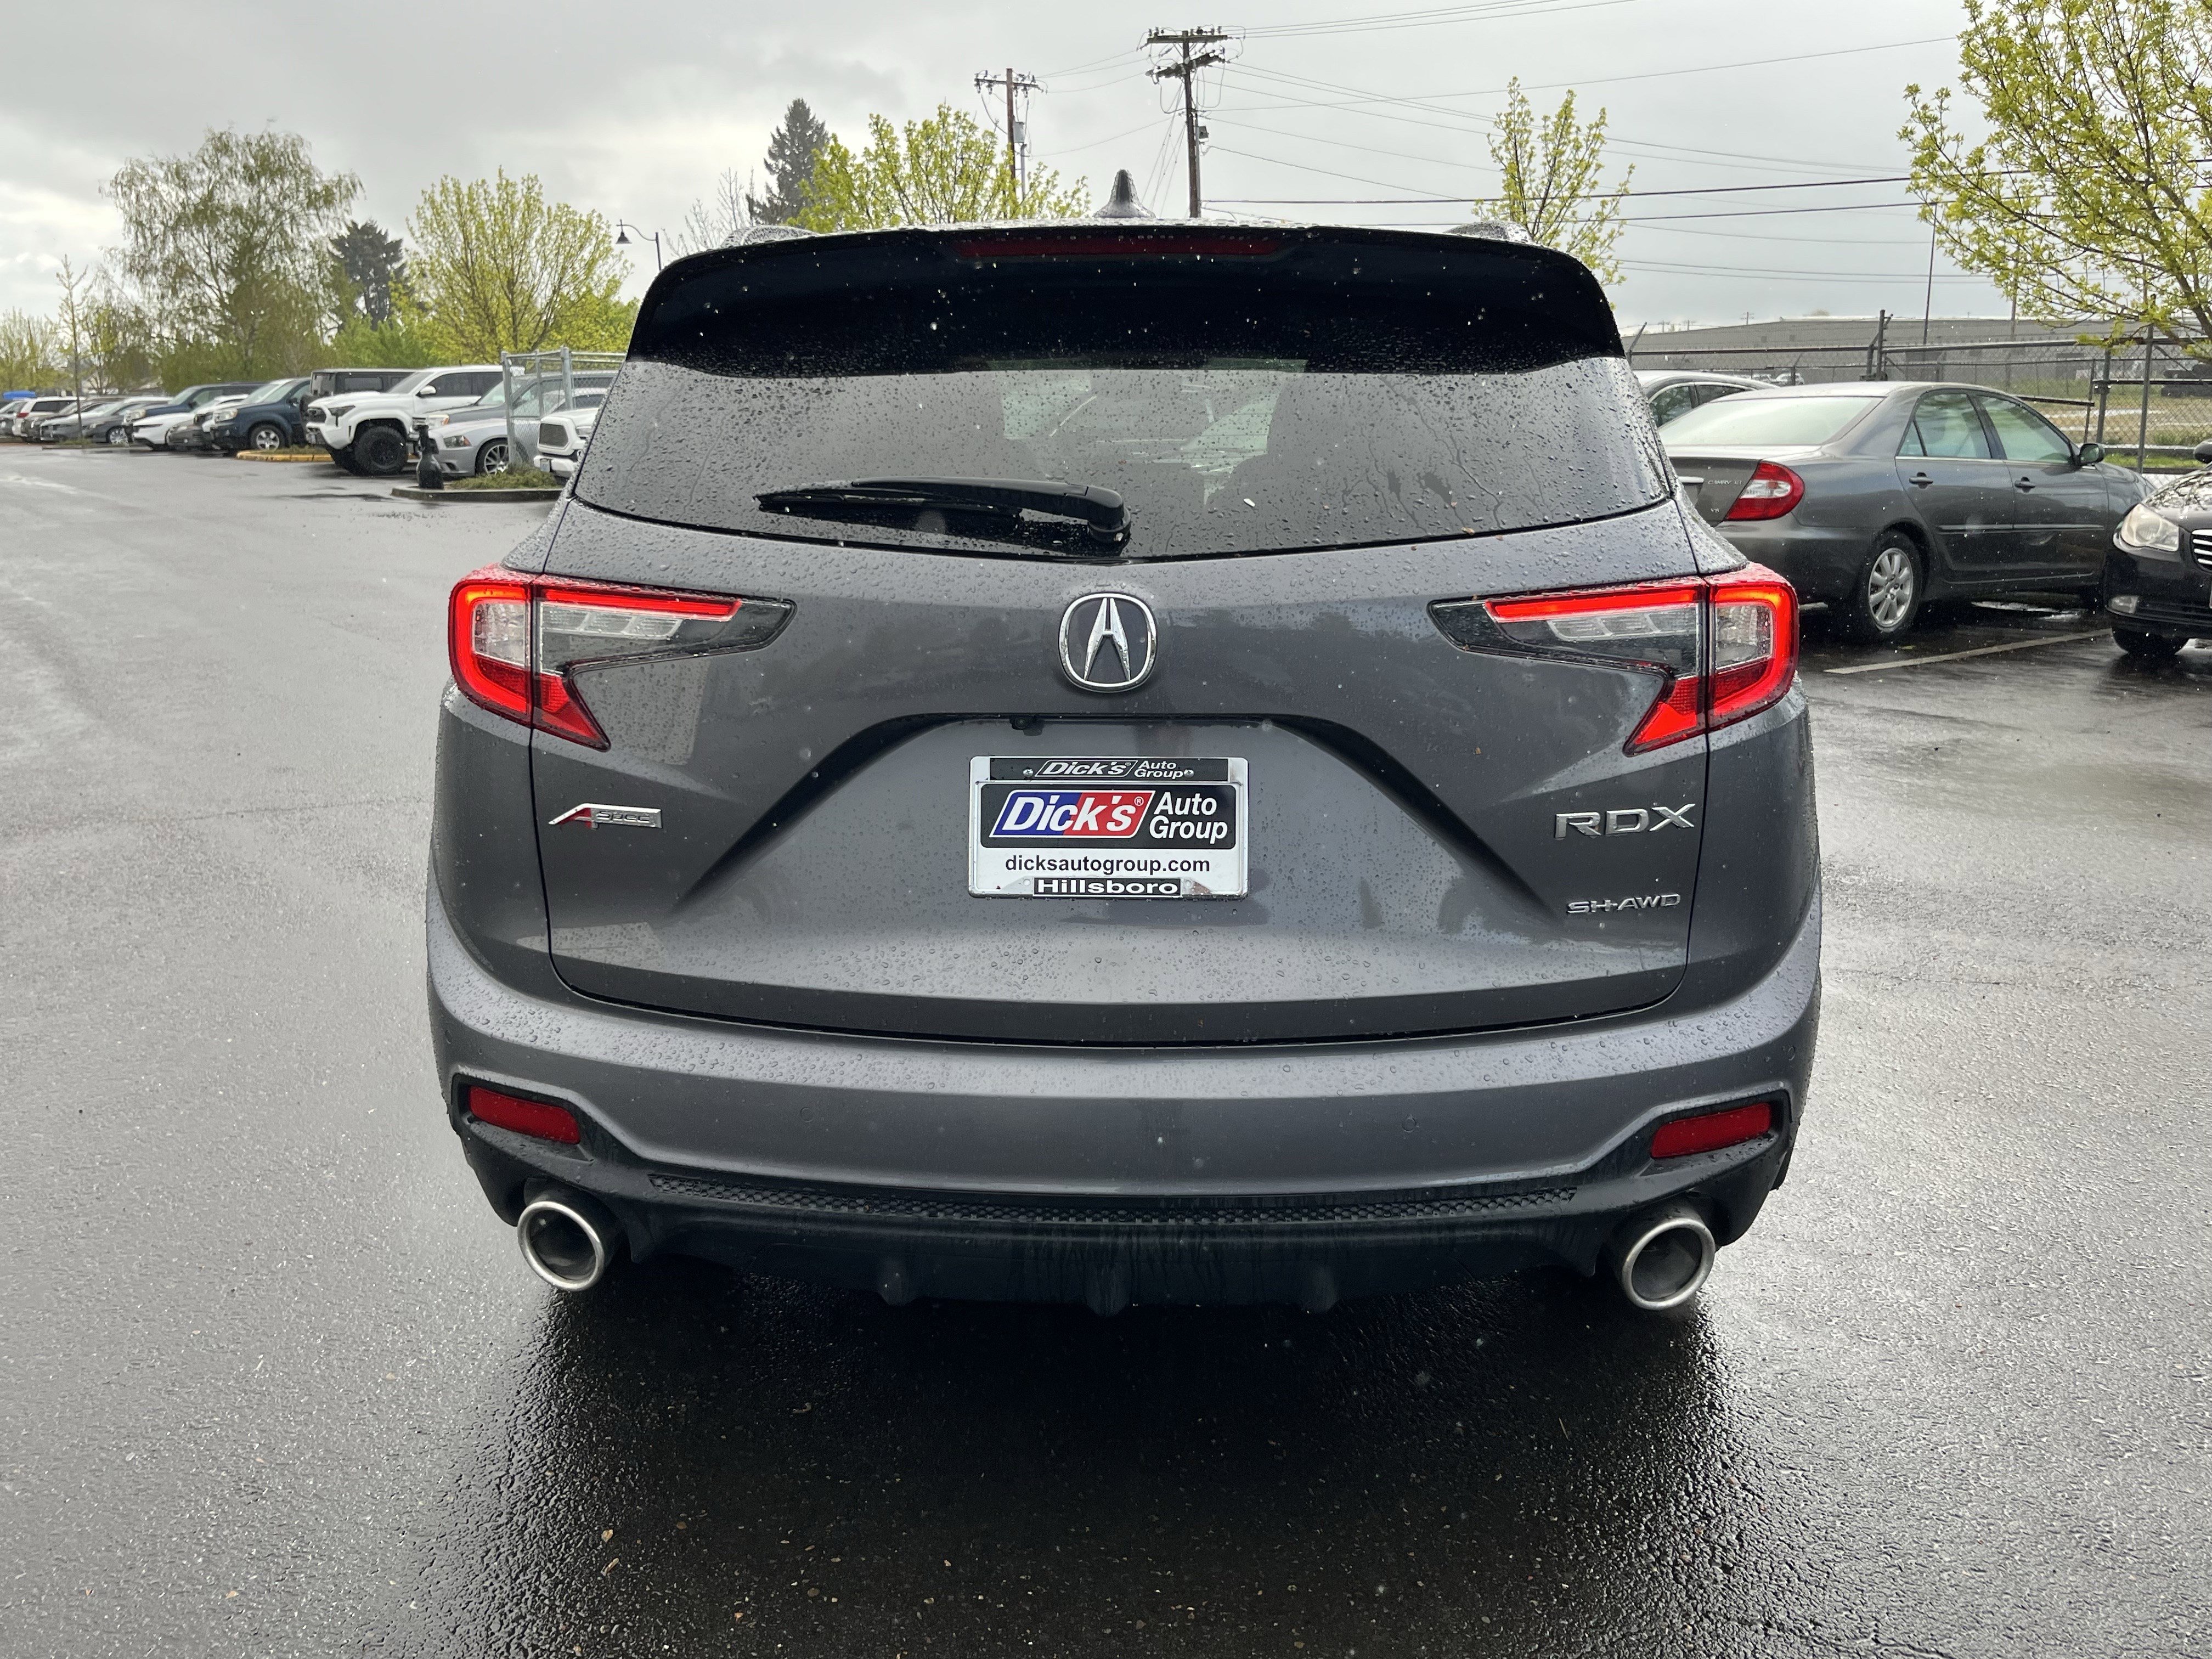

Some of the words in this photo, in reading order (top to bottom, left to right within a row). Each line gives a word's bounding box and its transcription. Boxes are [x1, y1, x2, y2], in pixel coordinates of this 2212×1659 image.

[1138, 760, 1177, 769] Auto
[1134, 769, 1183, 780] Group
[1153, 791, 1217, 816] Auto
[1149, 815, 1228, 844] Group
[1555, 803, 1696, 838] RDX
[1005, 855, 1210, 875] dicksautogroup.com
[1037, 879, 1178, 895] Hillsboro
[1566, 894, 1681, 913] SH-AWD
